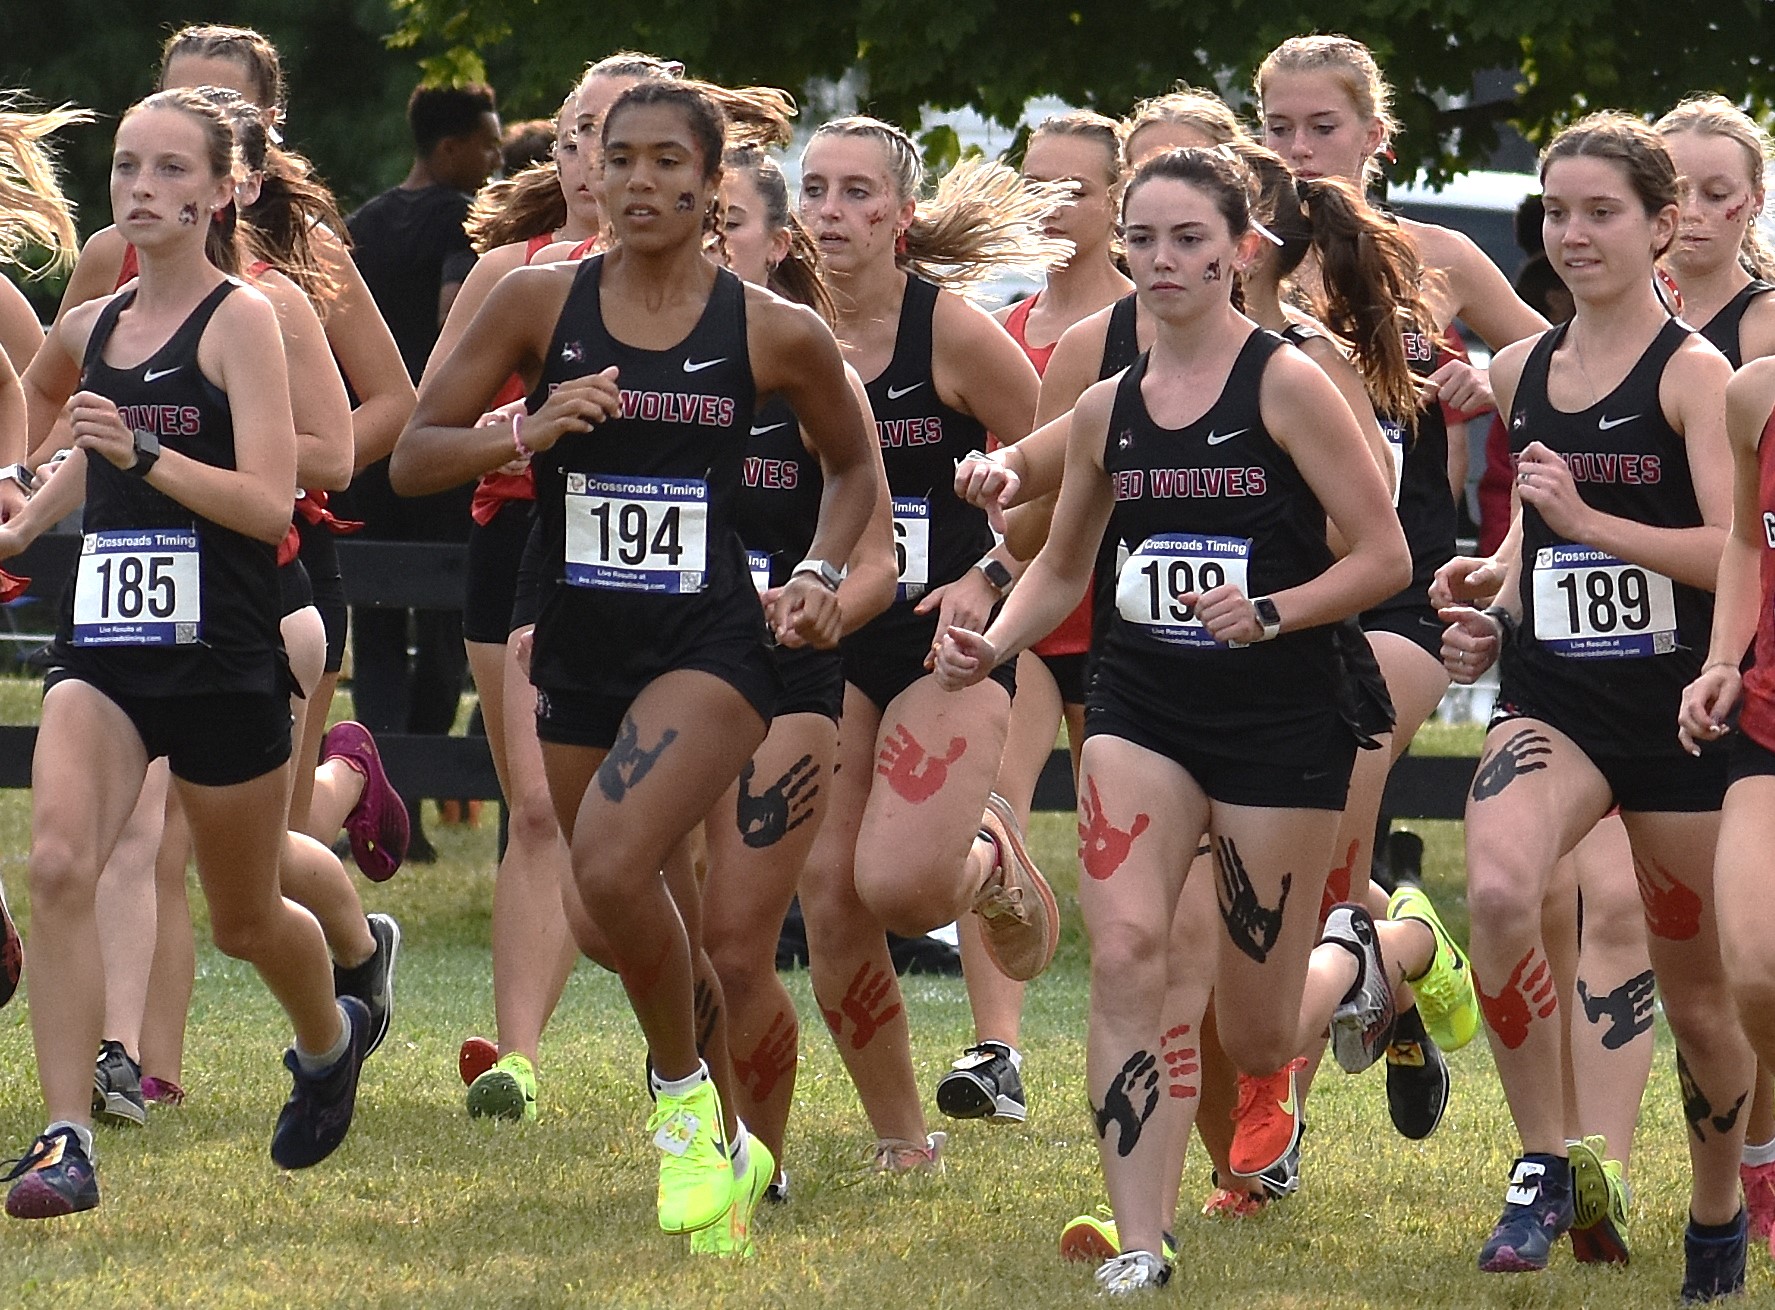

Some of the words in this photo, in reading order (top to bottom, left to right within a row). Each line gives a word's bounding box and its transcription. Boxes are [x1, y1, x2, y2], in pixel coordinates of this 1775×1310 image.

[116, 403, 200, 436] OLVES
[619, 389, 735, 428] WOLVES
[875, 416, 943, 448] LVES
[741, 456, 799, 490] VES
[1150, 466, 1267, 499] WOLVES
[1557, 452, 1661, 485] OLVES
[588, 478, 658, 495] Crossroads
[662, 483, 705, 498] Timing
[891, 501, 927, 515] iming
[97, 534, 152, 548] Crossroads
[154, 534, 196, 548] Timing
[590, 501, 683, 566] 194
[1144, 539, 1203, 551] Crossroads
[1206, 540, 1247, 555] Timing
[1554, 550, 1617, 563] Crossroa
[96, 556, 176, 619] 185
[1557, 568, 1652, 634] 189
